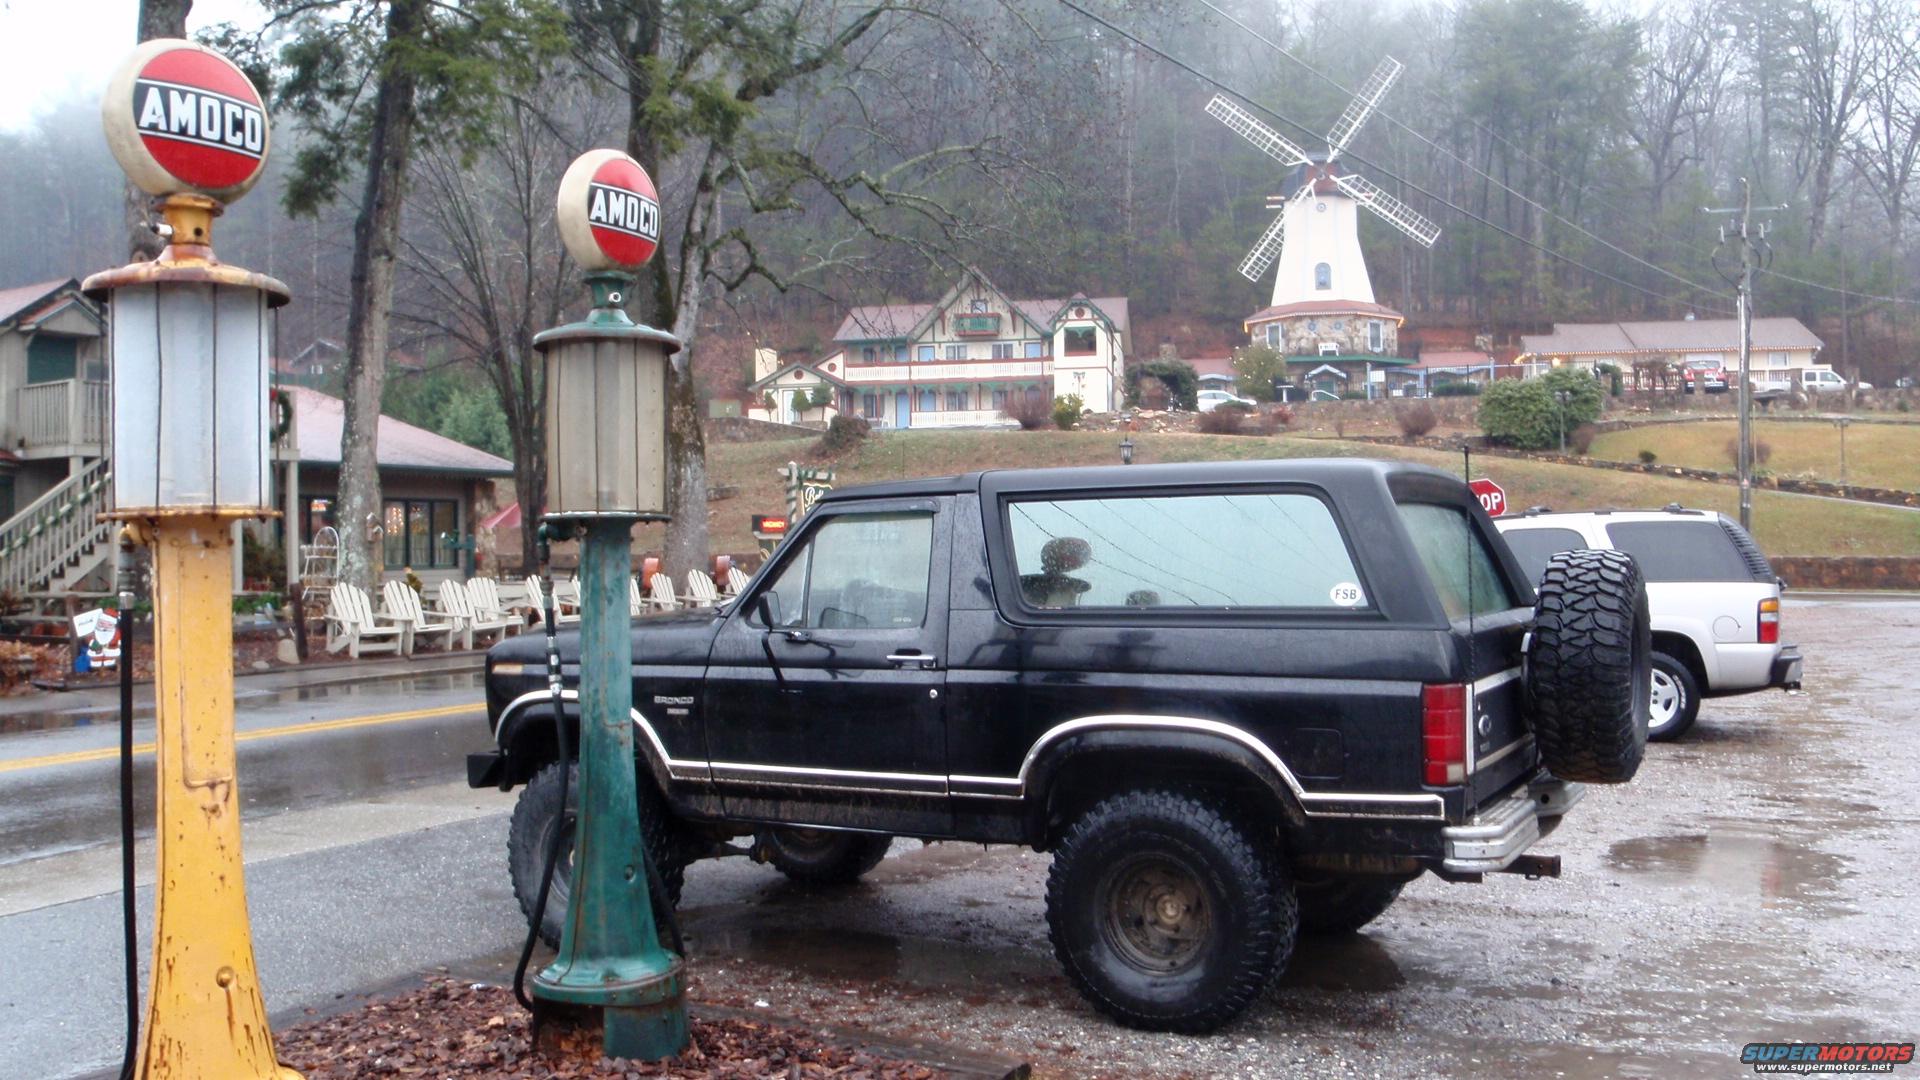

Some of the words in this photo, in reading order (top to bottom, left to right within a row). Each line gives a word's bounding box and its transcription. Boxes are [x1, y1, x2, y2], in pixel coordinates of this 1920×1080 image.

[138, 86, 263, 152] AMOCO
[589, 188, 659, 238] AMOCO
[1476, 492, 1502, 511] OP
[1335, 588, 1357, 600] FSB
[653, 695, 695, 704] BRONCO
